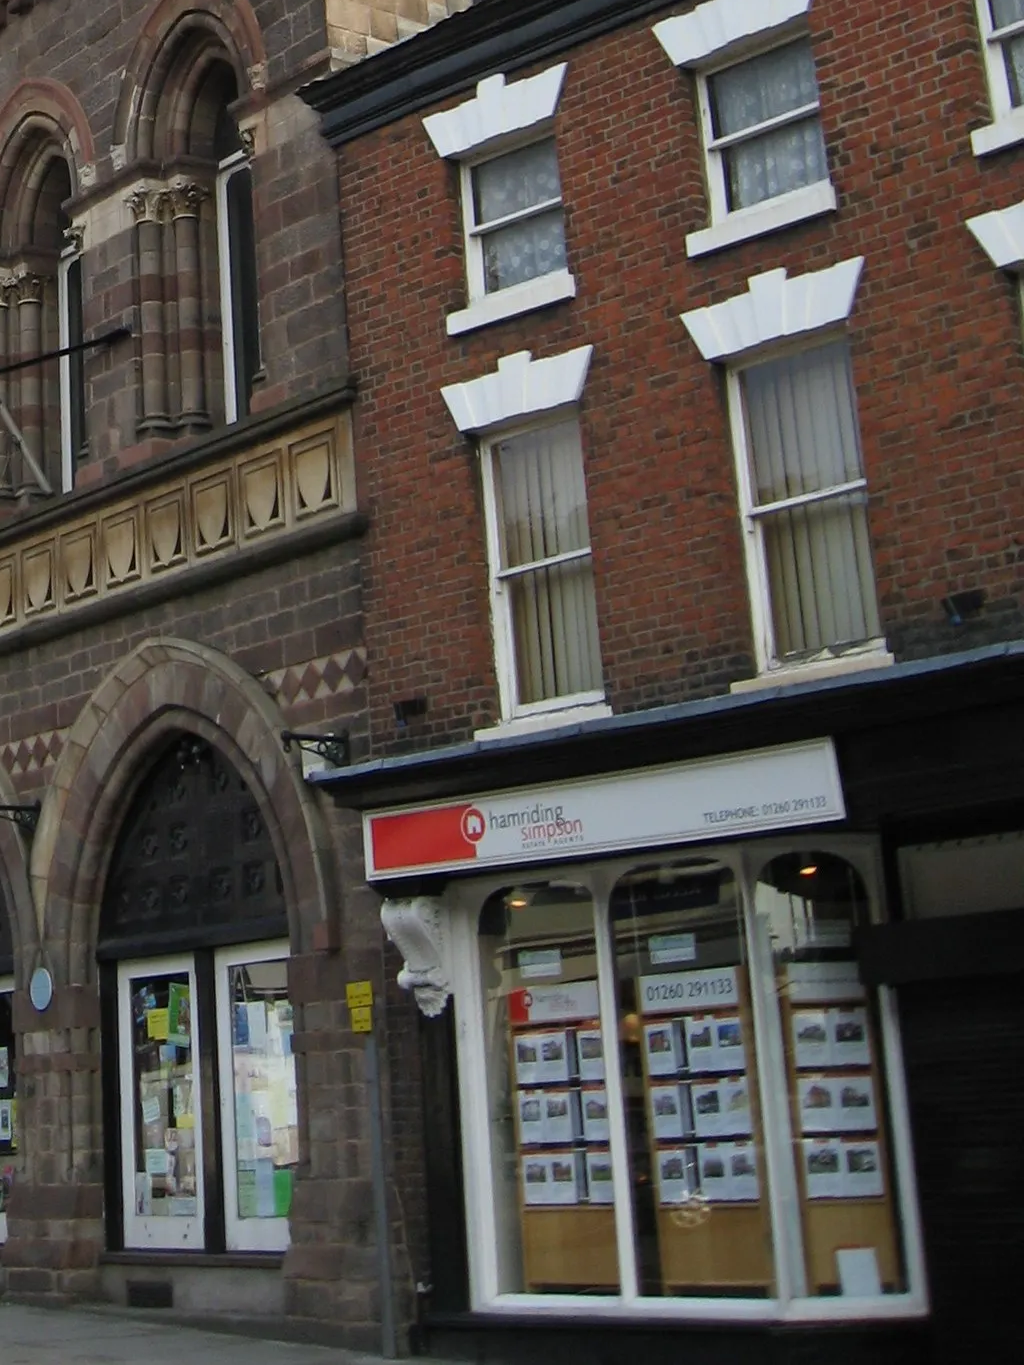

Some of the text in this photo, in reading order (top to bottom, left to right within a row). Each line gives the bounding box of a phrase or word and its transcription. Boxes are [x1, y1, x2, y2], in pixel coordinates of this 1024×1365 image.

[489, 803, 566, 830] hamriding
[703, 795, 828, 823] TELEPHONE: 01260 291133
[521, 818, 583, 843] simpson
[554, 834, 585, 846] AGENTS
[646, 978, 734, 1002] 01260 291133
